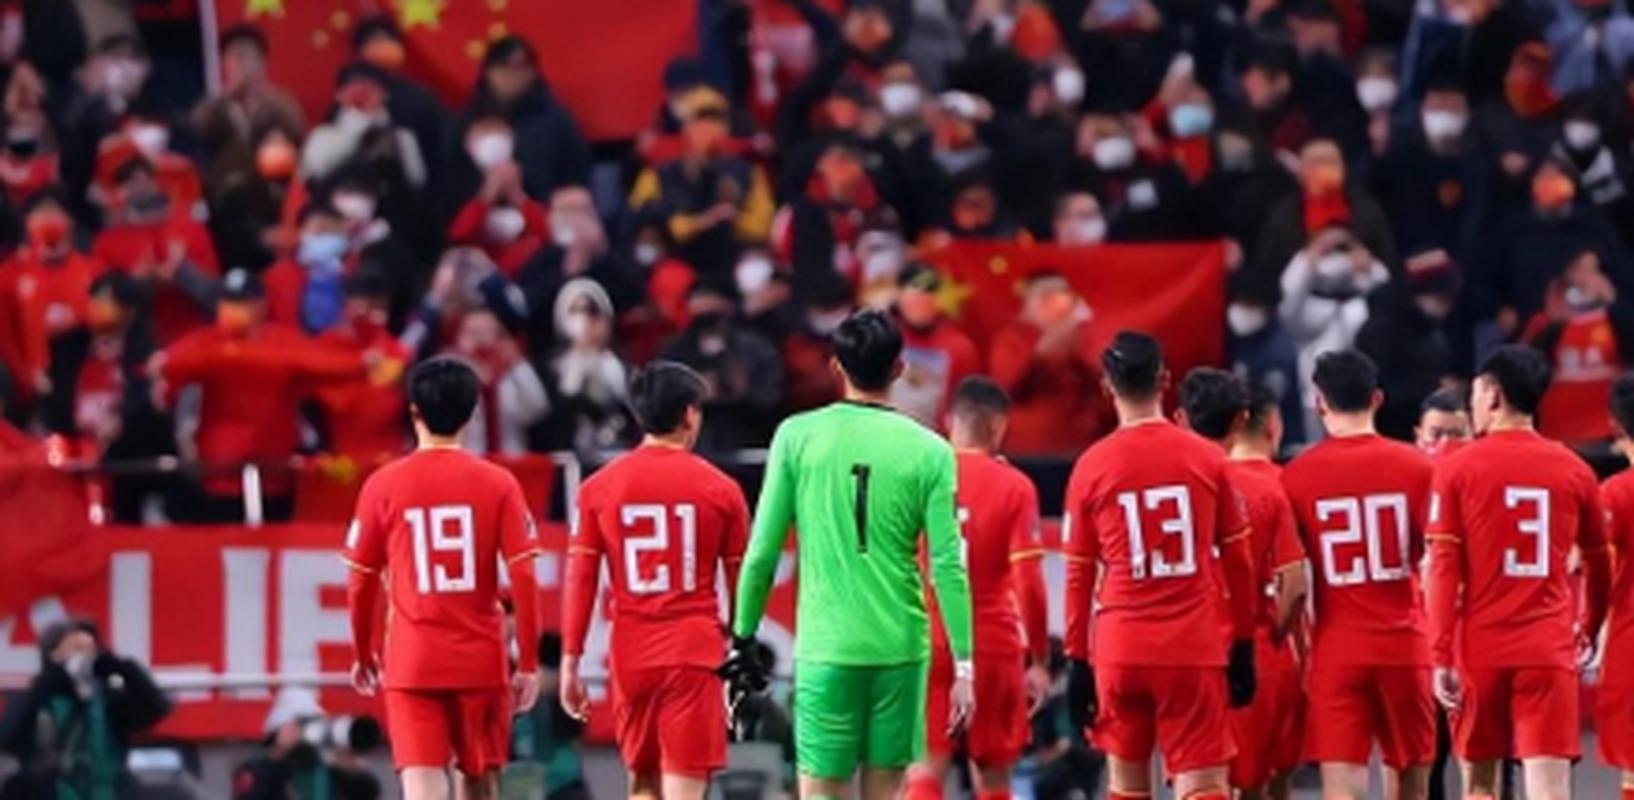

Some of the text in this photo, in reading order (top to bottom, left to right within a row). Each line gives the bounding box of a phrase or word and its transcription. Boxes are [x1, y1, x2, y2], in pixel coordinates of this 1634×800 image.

[403, 504, 475, 594] 19
[621, 503, 697, 594] 21
[851, 463, 870, 554] 1
[1117, 485, 1196, 579] 13
[1315, 492, 1411, 586] 20
[1504, 486, 1550, 577] 3
